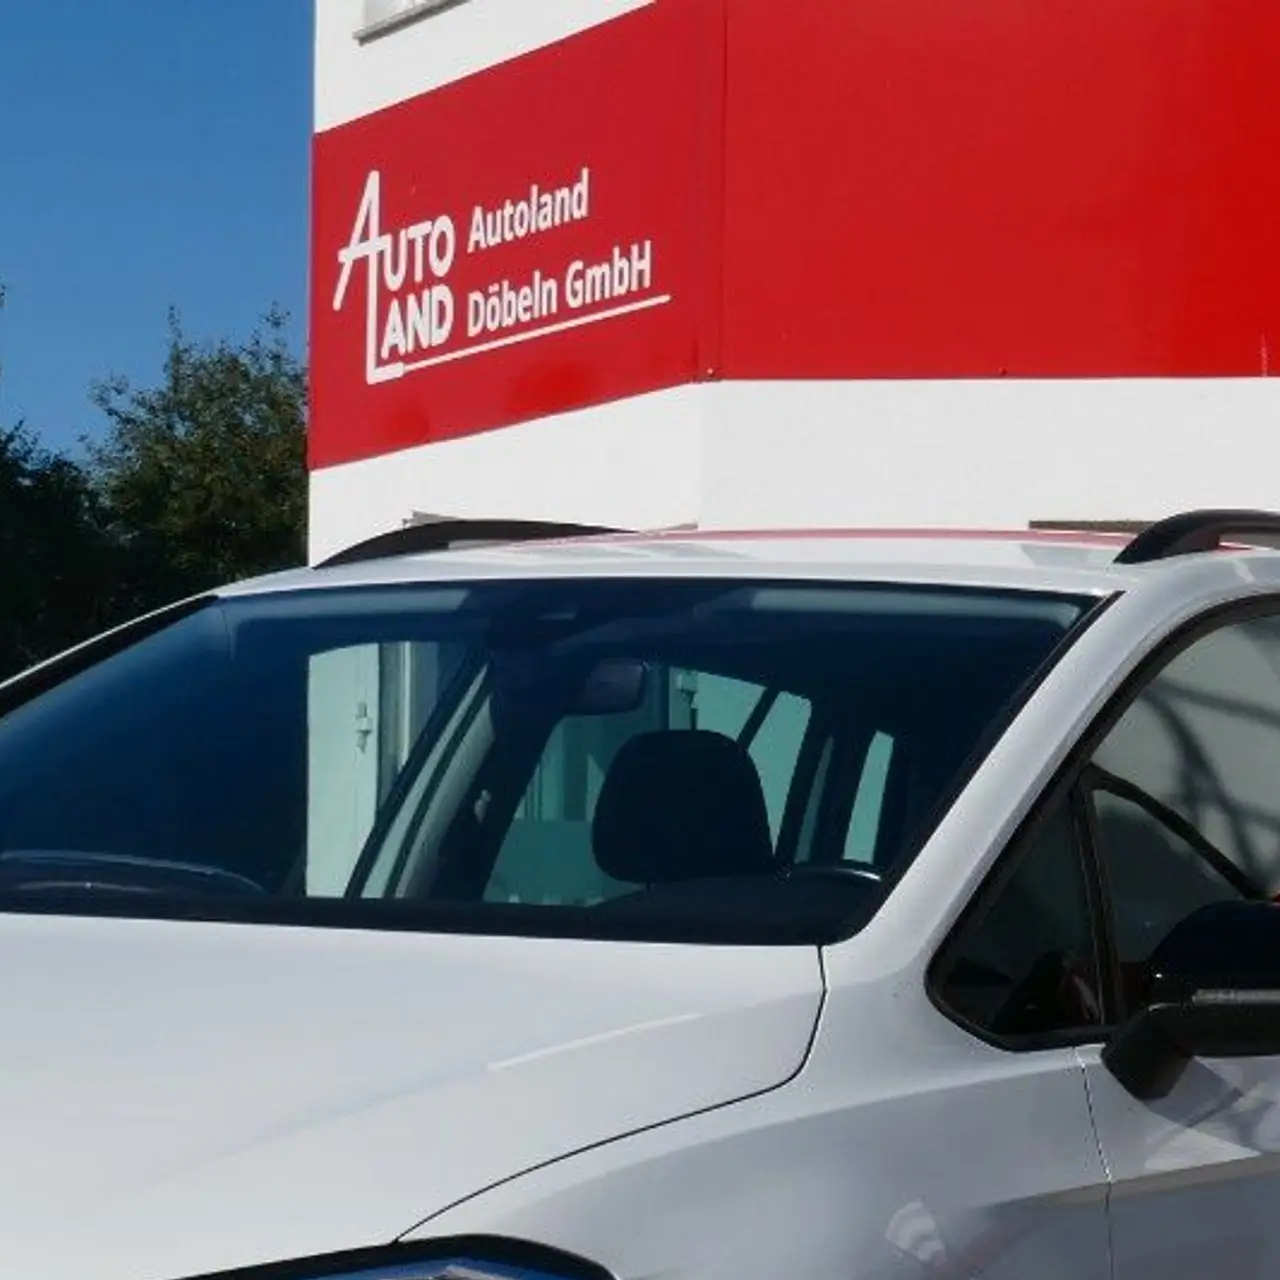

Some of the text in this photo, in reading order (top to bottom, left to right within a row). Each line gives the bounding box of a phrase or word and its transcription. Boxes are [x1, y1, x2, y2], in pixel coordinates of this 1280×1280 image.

[332, 169, 456, 312] AUTO
[467, 167, 589, 253] Autoland
[365, 283, 455, 385] LAND
[467, 239, 652, 337] Döbeln GmbH
